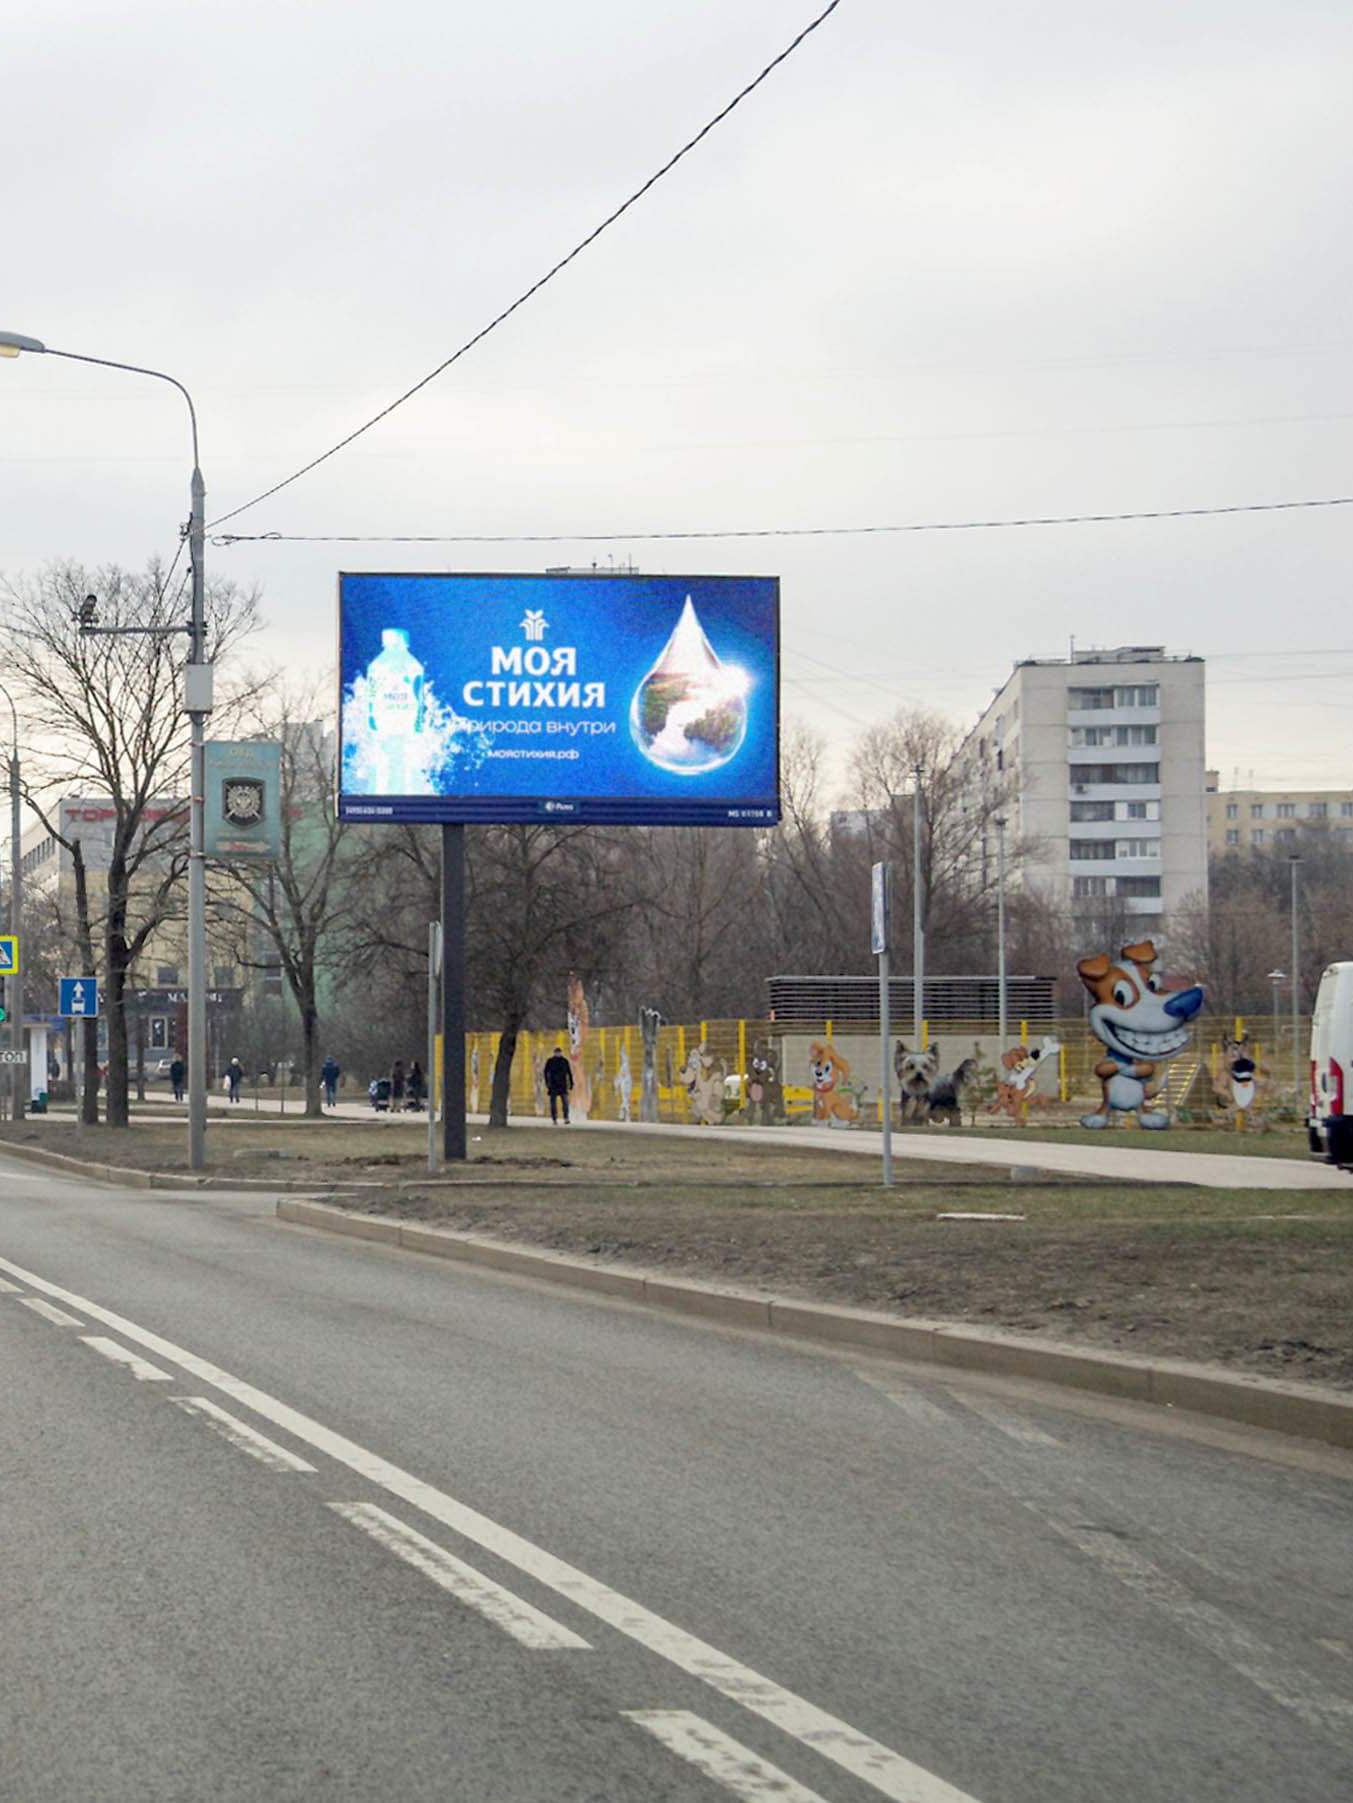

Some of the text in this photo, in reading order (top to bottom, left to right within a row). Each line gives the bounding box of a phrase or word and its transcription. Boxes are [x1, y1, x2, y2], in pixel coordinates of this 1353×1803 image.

[491, 646, 577, 676] МОЯ
[462, 680, 606, 708] СТИХИЯ
[546, 720, 617, 736] внутри
